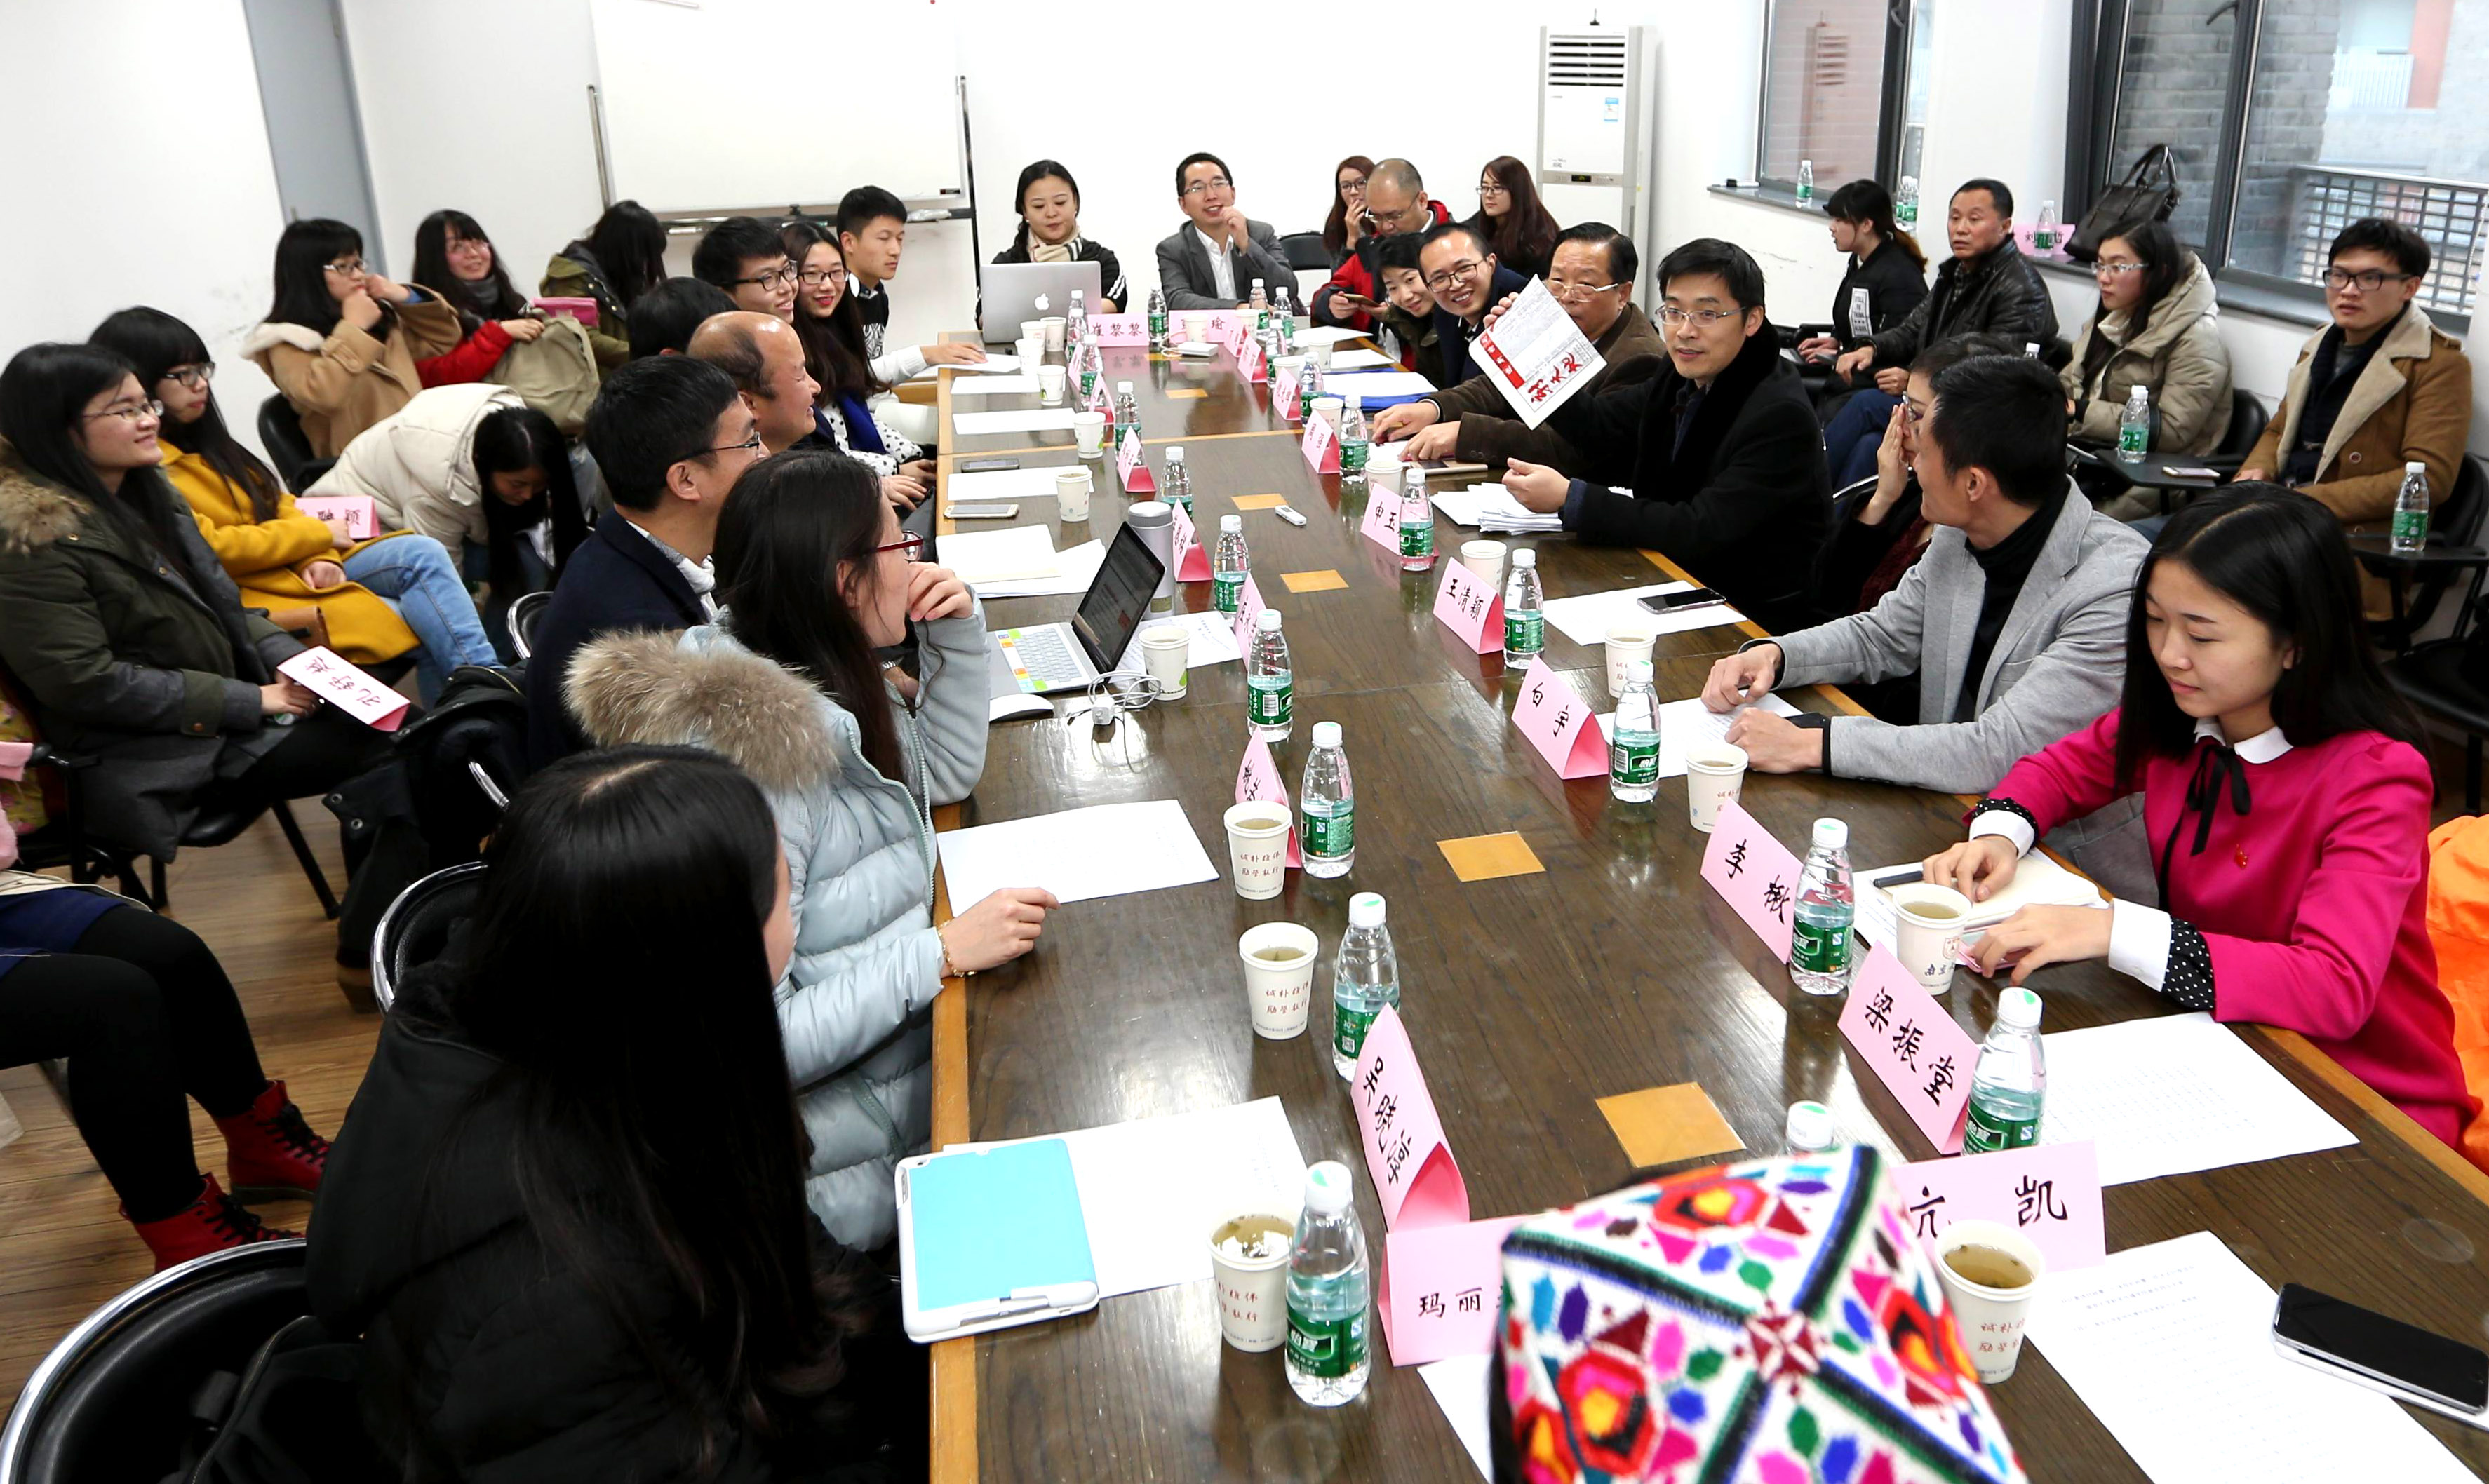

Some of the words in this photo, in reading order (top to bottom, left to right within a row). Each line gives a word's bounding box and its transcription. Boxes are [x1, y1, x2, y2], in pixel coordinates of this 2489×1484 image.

[1374, 501, 1400, 534] 申玉
[1864, 985, 1955, 1107] 梁振堂
[1363, 1056, 1412, 1187] 吴晓淳
[1418, 1286, 1503, 1319] 玛丽
